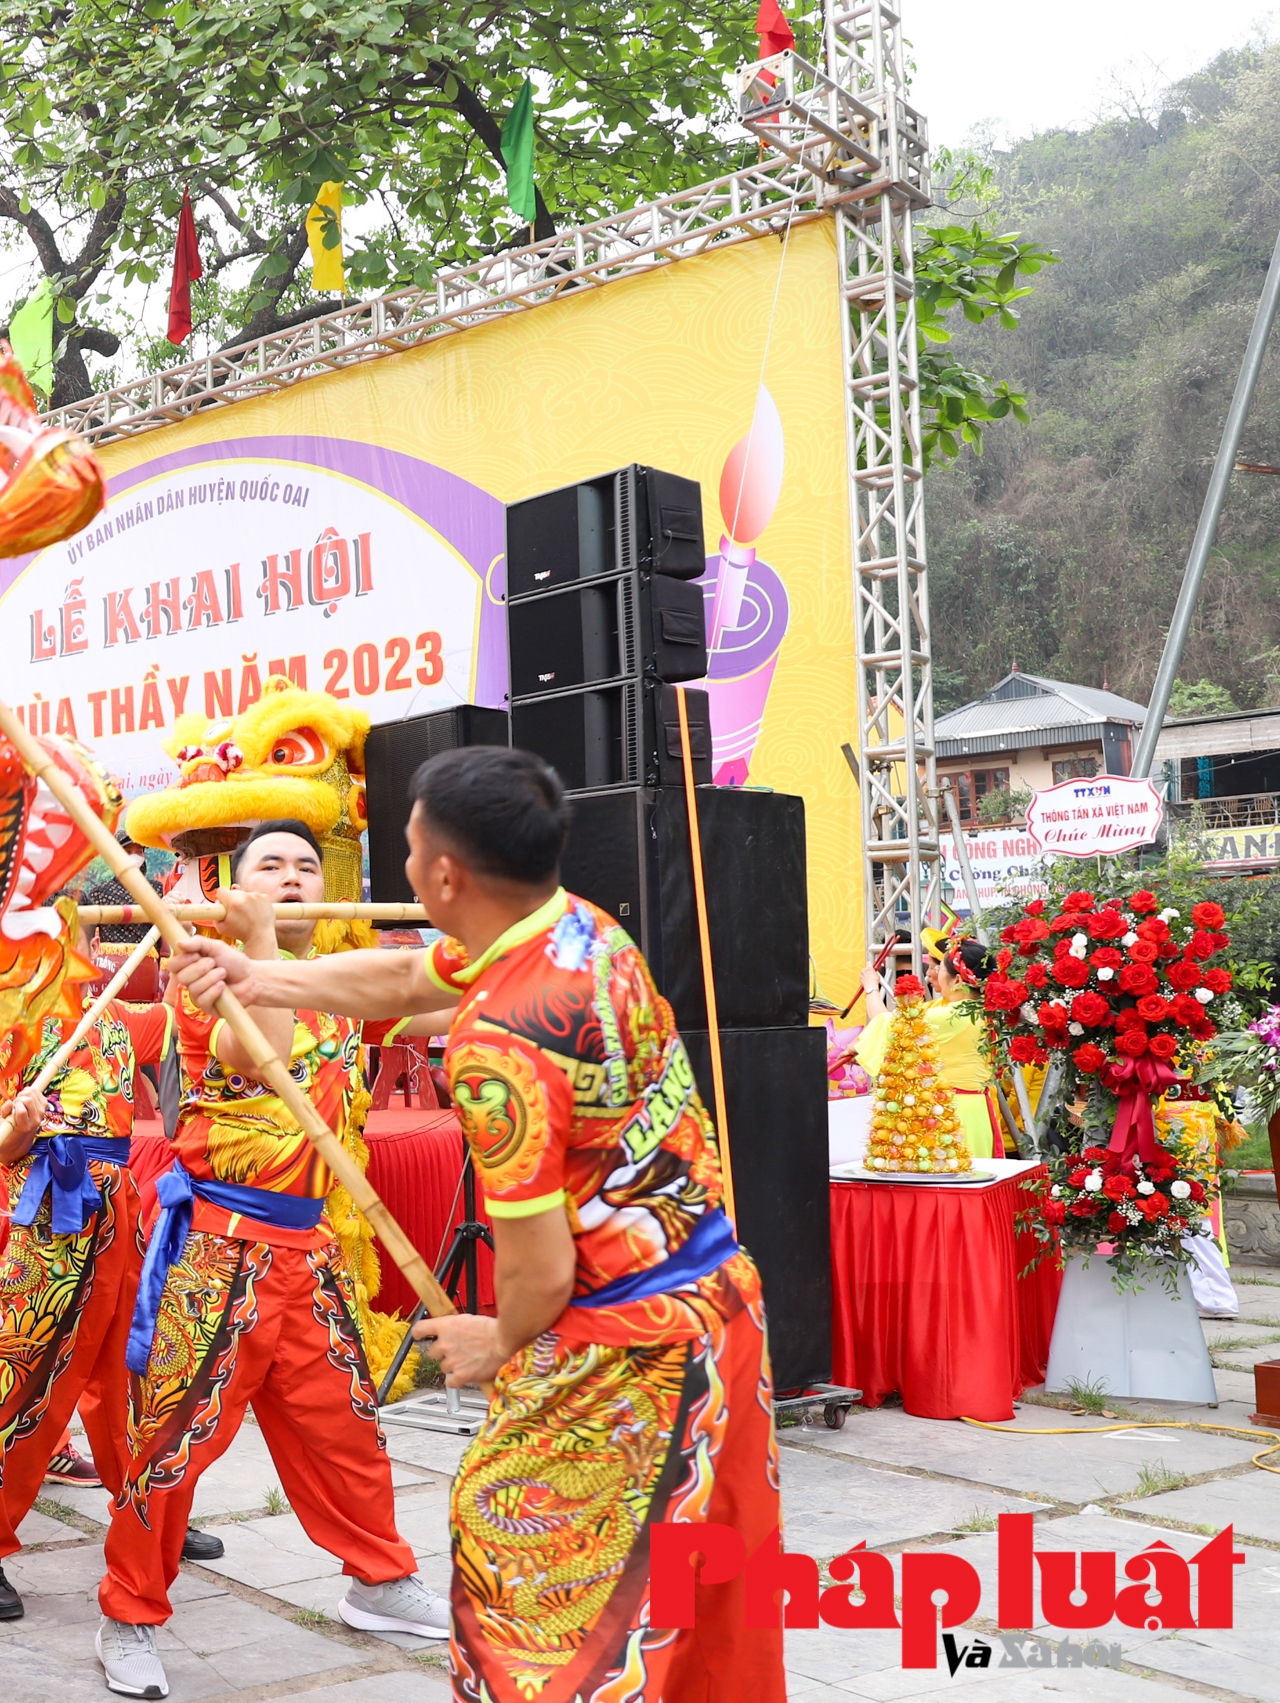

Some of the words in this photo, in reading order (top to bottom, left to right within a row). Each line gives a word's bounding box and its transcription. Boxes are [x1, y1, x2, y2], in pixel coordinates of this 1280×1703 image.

[86, 521, 114, 552] BAN
[115, 500, 154, 534] NHÂN
[157, 489, 185, 516] DÂN
[188, 478, 236, 506] HUYỆN
[239, 474, 280, 502] QUỐC
[282, 482, 310, 508] OAI
[30, 576, 89, 663] LỄ
[102, 562, 244, 649] KHAI
[256, 526, 374, 619] HỘI
[87, 663, 191, 738] THẦY
[323, 630, 445, 700] 2023
[139, 768, 173, 791] ngày
[1041, 809, 1069, 823] THÔNG
[1072, 804, 1089, 820] TẤN
[1092, 804, 1104, 818] XÃ
[1106, 802, 1125, 818] VIỆT
[1127, 802, 1148, 815] NAM
[1044, 828, 1088, 844] Chúc
[1092, 824, 1147, 839] Mừng
[1003, 836, 1037, 857] NGH
